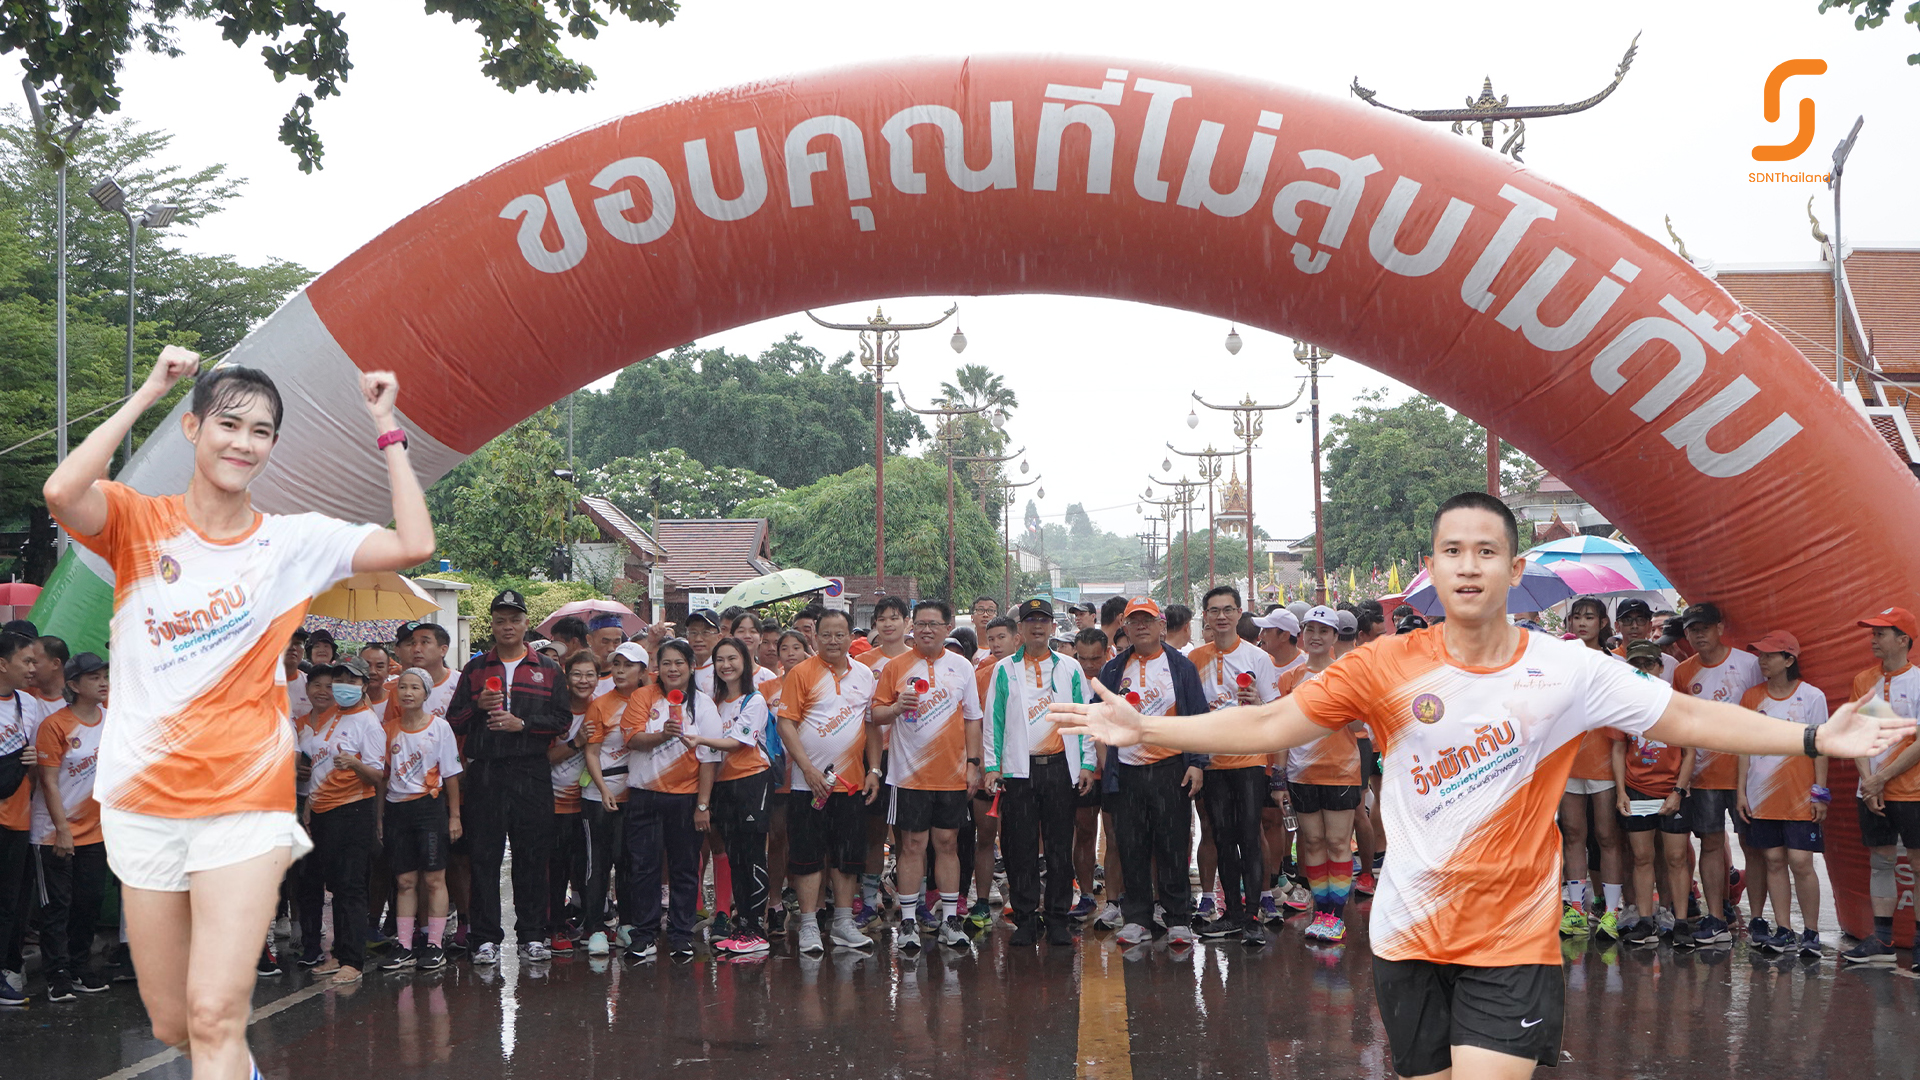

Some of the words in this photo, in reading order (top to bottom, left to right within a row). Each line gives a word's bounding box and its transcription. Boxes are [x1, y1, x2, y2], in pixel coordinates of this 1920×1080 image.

[144, 584, 247, 647] วิ่งพักตับ
[1411, 719, 1516, 796] วิ่งพักตับ
[1439, 745, 1520, 798] SobrietyRunClub
